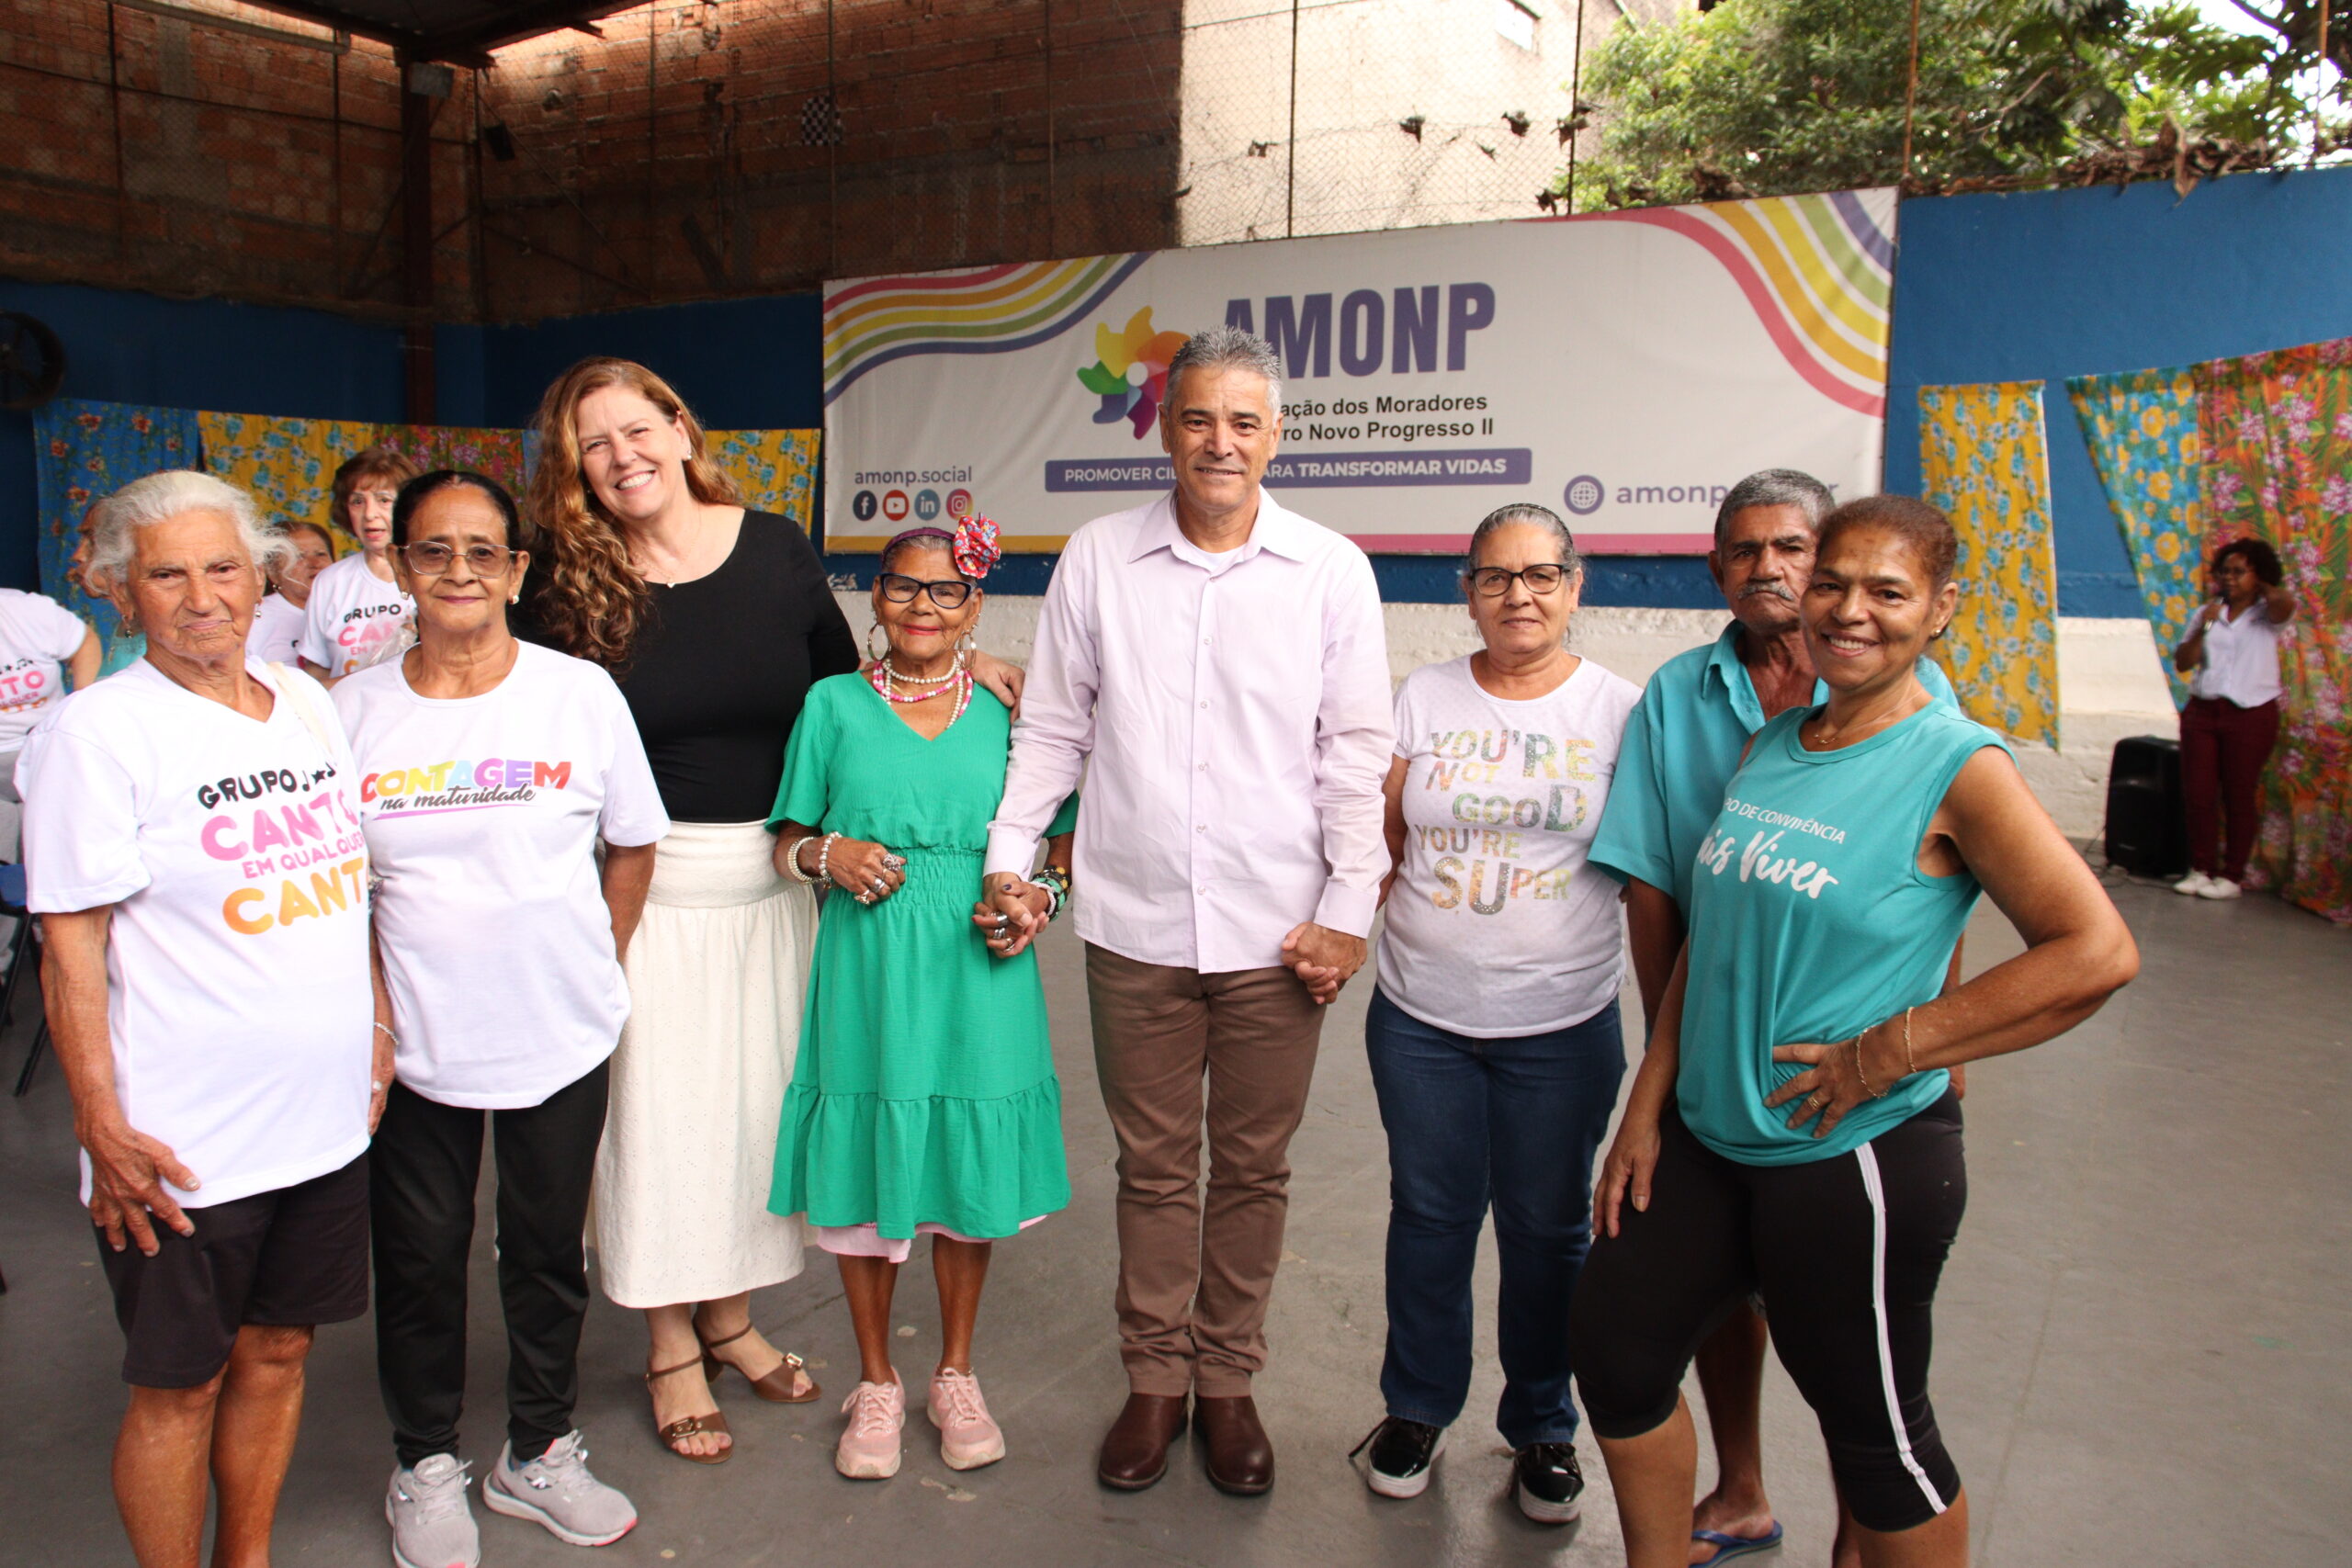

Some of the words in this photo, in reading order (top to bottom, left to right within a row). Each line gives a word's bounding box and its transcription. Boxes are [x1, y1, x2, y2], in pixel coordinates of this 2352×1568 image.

[1332, 398, 1368, 415] dos
[1376, 394, 1487, 413] Moradores
[1309, 423, 1360, 440] Novo
[1367, 422, 1475, 442] Progresso
[854, 465, 973, 488] amonp.social
[1065, 467, 1152, 482] PROMOVER
[1298, 460, 1442, 478] TRANSFORMAR
[1445, 458, 1507, 475] VIDAS
[1430, 729, 1597, 782] YOU'RE
[198, 769, 298, 810] GRUPO
[360, 758, 572, 804] CONTAGEM
[1425, 761, 1500, 792] NOT
[379, 796, 407, 811] na
[413, 781, 537, 808] maturidade
[1452, 784, 1589, 832] GOOD
[1737, 803, 1760, 819] DE
[1415, 824, 1523, 860] YOU'RE
[242, 857, 277, 879] EM
[1739, 829, 1839, 899] Viver
[221, 856, 365, 936] CANT
[1431, 856, 1573, 916] SUPER
